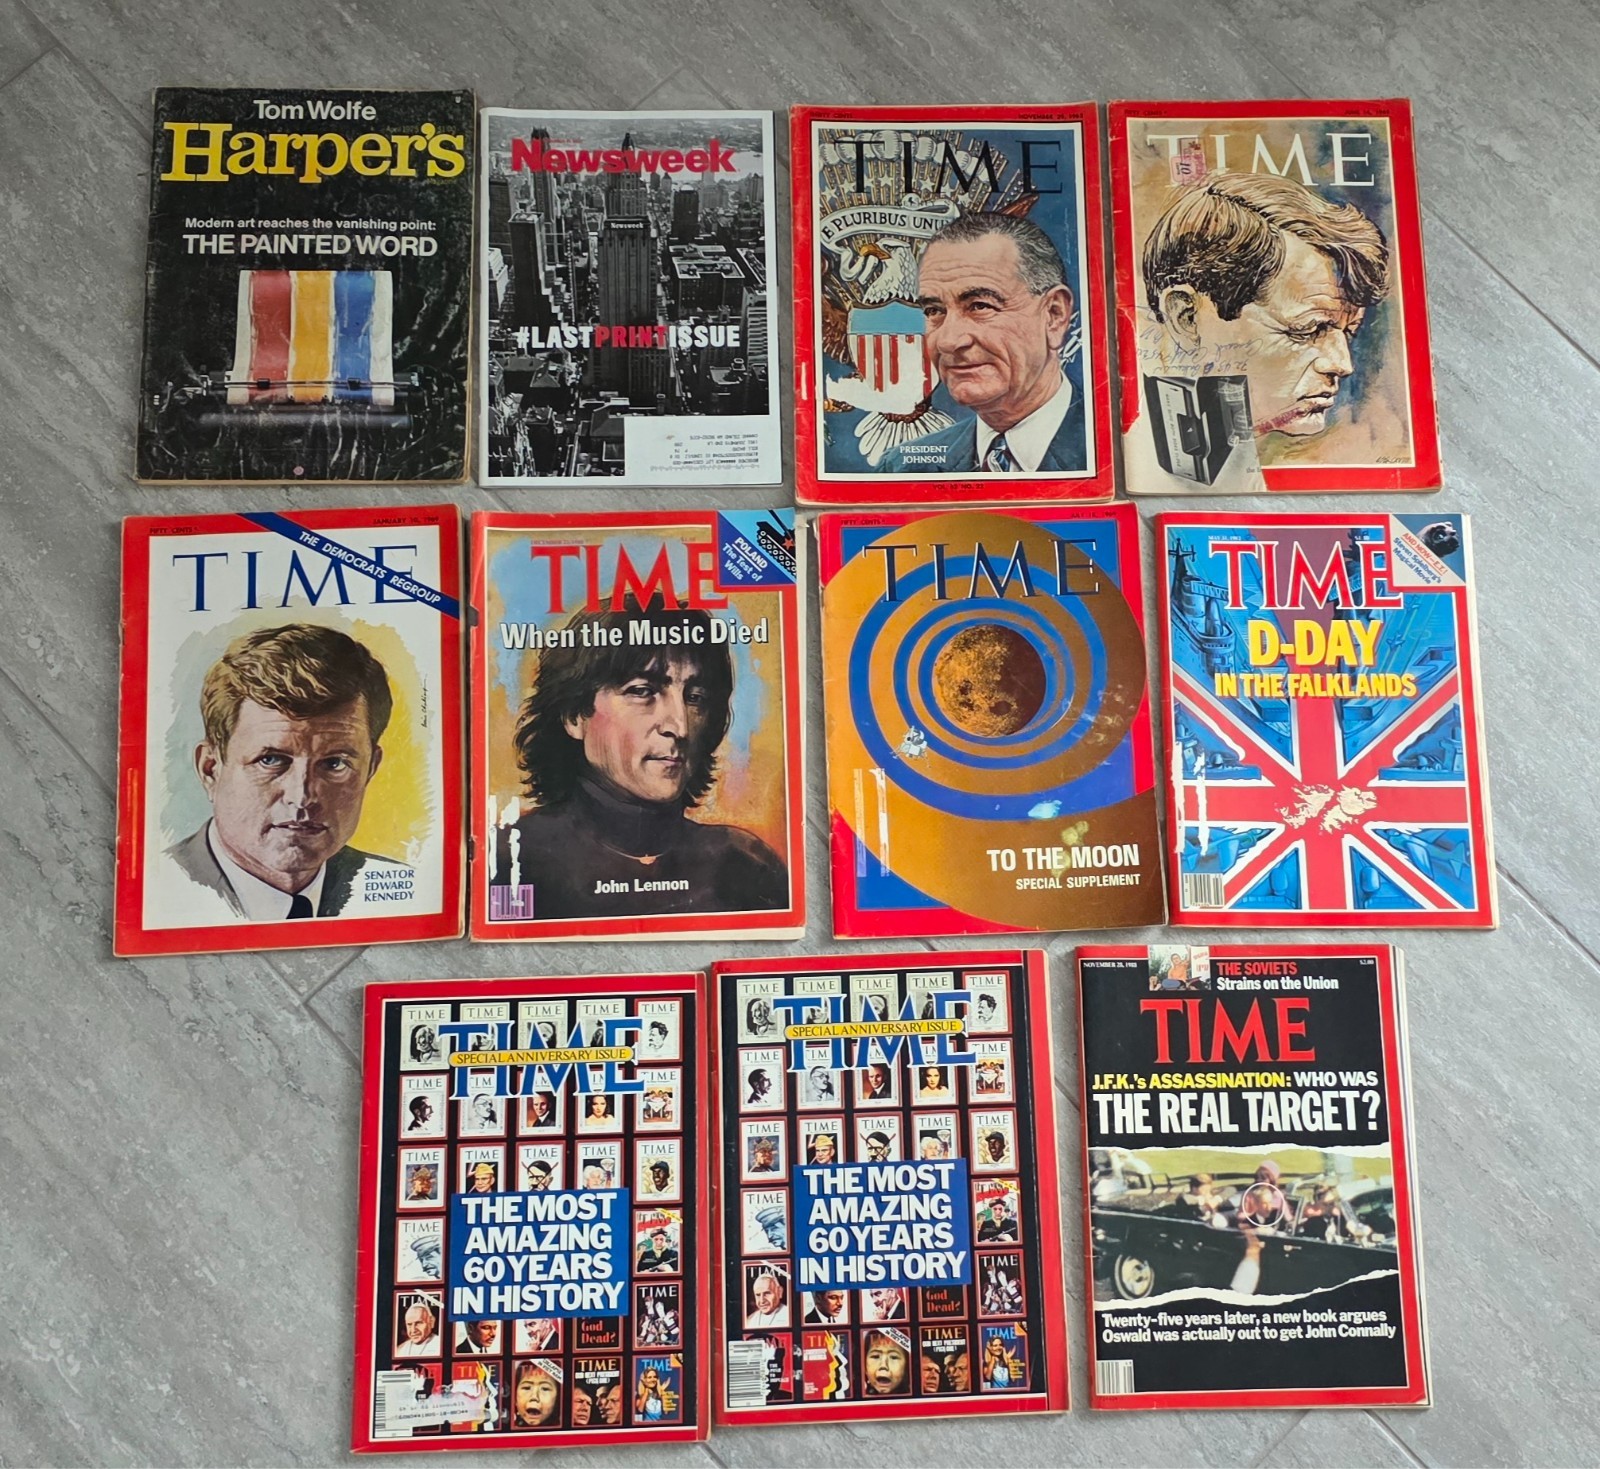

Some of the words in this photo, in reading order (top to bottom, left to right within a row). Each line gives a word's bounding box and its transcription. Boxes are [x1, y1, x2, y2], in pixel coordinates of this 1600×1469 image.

[253, 100, 305, 120] Tom
[306, 101, 377, 120] Wolfe
[160, 122, 465, 183] Harper's
[511, 138, 737, 173] Newsweek
[1147, 132, 1375, 188] TIME
[834, 139, 1063, 194] TIME
[185, 218, 234, 229] Modern
[237, 219, 256, 229] art
[257, 219, 310, 229] reaches
[312, 218, 333, 229] the
[336, 219, 398, 232] vanishing
[400, 219, 437, 232] point:
[610, 222, 644, 230] Newsweek
[821, 225, 835, 240] E
[831, 211, 907, 230] PLURIBUS
[183, 234, 235, 255] THE
[240, 234, 352, 255] PAINTED
[355, 235, 438, 257] WORD
[900, 445, 948, 454] PRESIDENT
[902, 455, 946, 464] JOHNSON
[1402, 532, 1418, 547] AND
[734, 537, 768, 569] POLAND
[1393, 537, 1413, 557] Steven
[1411, 553, 1442, 583] Spielberg's
[299, 531, 320, 547] THE
[322, 542, 388, 579] DEMOCRATS
[390, 575, 441, 603] REGROUP
[722, 542, 737, 560] The
[737, 556, 753, 575] Test
[751, 571, 763, 582] of
[724, 560, 743, 580] Wills
[861, 538, 1099, 602] TIME
[1393, 547, 1415, 570] Magical
[1414, 567, 1431, 584] Movie
[172, 545, 418, 612] TIME
[530, 543, 728, 614] TIME
[1210, 541, 1404, 610] TIME
[500, 621, 575, 650] When
[581, 620, 623, 647] the
[629, 618, 704, 646] Music
[710, 616, 768, 645] Died
[1247, 619, 1381, 666] D-DAY
[1214, 672, 1239, 697] IN
[1239, 673, 1284, 698] THE
[1288, 673, 1417, 698] FALKLANDS
[987, 848, 1016, 871] TO
[1022, 847, 1066, 870] THE
[1071, 844, 1139, 868] MOON
[364, 869, 415, 880] SENATOR
[1016, 878, 1062, 890] SPECIAL
[1066, 873, 1141, 888] SUPPLEMENT
[365, 880, 413, 890] EDWARD
[594, 879, 629, 894] John
[633, 877, 689, 892] Lennon
[364, 891, 415, 902] KENNEDY
[1216, 962, 1242, 975] THE
[1244, 961, 1297, 975] SOVIETS
[742, 982, 779, 994] TIME
[799, 980, 836, 992] TIME
[856, 978, 893, 989] TIME
[911, 976, 948, 988] TIME
[969, 975, 1007, 987] TIME
[1216, 977, 1261, 990] Strains
[1263, 980, 1278, 990] on
[1280, 977, 1301, 990] the
[1303, 976, 1339, 990] Union
[408, 1008, 446, 1020] TIME
[466, 1006, 504, 1018] TIME
[525, 1004, 562, 1016] TIME
[583, 1003, 620, 1015] TIME
[641, 1002, 677, 1013] TIME
[772, 990, 976, 1073] TIME
[792, 1024, 839, 1037] SPECIAL
[841, 1022, 924, 1036] ANNIVERSARY
[927, 1020, 958, 1032] ISSUE
[1140, 997, 1316, 1064] TIME
[437, 1017, 645, 1100] TIME
[457, 1051, 506, 1064] SPECIAL
[507, 1049, 592, 1063] ANNIVERSARY
[595, 1048, 627, 1060] ISSUE
[744, 1050, 780, 1062] TIME
[405, 1077, 443, 1089] TIME
[1092, 1073, 1147, 1090] J.F.K.'s
[1148, 1072, 1291, 1089] ASSASSINATION:
[1293, 1071, 1336, 1087] WHO
[1337, 1070, 1379, 1087] WAS
[976, 1115, 1010, 1126] TIME
[1092, 1092, 1153, 1134] THE
[1159, 1091, 1240, 1133] REAL
[1241, 1090, 1381, 1132] TARGET?
[747, 1123, 780, 1134] TIME
[805, 1121, 839, 1133] TIME
[861, 1119, 895, 1130] TIME
[918, 1117, 952, 1128] TIME
[405, 1150, 440, 1162] TIME
[465, 1149, 499, 1160] TIME
[524, 1148, 559, 1159] TIME
[582, 1145, 616, 1157] TIME
[641, 1144, 676, 1155] TIME
[803, 1169, 862, 1195] THE
[867, 1164, 955, 1193] MOST
[461, 1197, 522, 1224] THE
[525, 1192, 617, 1223] MOST
[809, 1193, 952, 1225] AMAZING
[464, 1223, 613, 1255] AMAZING
[809, 1226, 849, 1254] 60
[850, 1222, 954, 1252] YEARS
[464, 1255, 504, 1283] 60
[504, 1252, 613, 1282] YEARS
[799, 1256, 830, 1284] IN
[835, 1251, 966, 1282] HISTORY
[981, 1255, 1018, 1267] TIME
[453, 1286, 484, 1315] IN
[490, 1281, 625, 1313] HISTORY
[639, 1286, 677, 1298] TIME
[1102, 1312, 1183, 1329] Twenty-five
[1184, 1313, 1222, 1328] years
[1223, 1311, 1260, 1325] later,
[1262, 1313, 1270, 1323] a
[1272, 1312, 1300, 1323] new
[1302, 1309, 1338, 1323] book
[1339, 1310, 1387, 1324] argues
[924, 1327, 962, 1340] TIME
[1102, 1329, 1151, 1343] Oswald
[1153, 1331, 1180, 1342] was
[1181, 1328, 1236, 1344] actually
[1238, 1329, 1260, 1340] out
[1262, 1329, 1278, 1340] to
[1280, 1328, 1303, 1342] get
[1304, 1324, 1337, 1339] John
[1338, 1322, 1396, 1340] Connally
[578, 1360, 616, 1371] TIME
